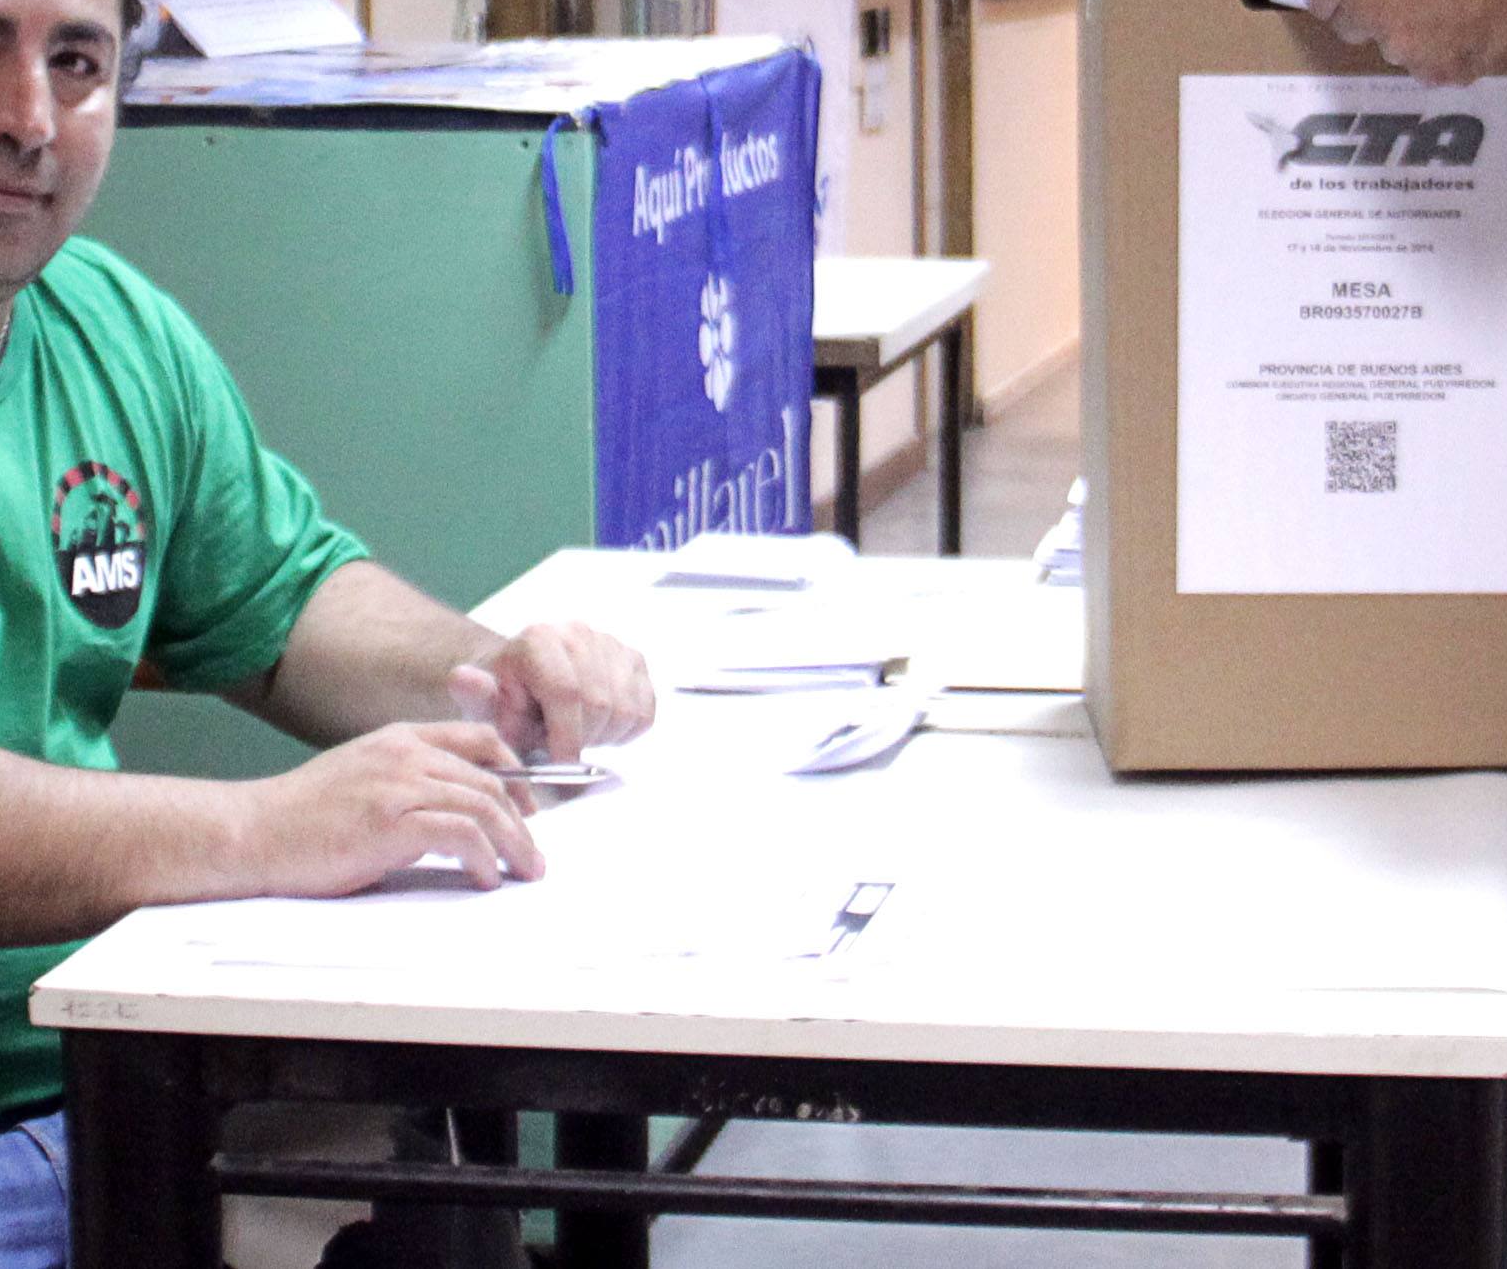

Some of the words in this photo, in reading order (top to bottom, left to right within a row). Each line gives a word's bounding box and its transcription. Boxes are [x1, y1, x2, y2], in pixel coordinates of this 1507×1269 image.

[1289, 178, 1313, 191] de
[1319, 178, 1345, 191] los
[1353, 177, 1475, 192] trabajadores
[1332, 282, 1392, 298] MESA
[1259, 364, 1333, 376] PROVINCIA
[1337, 364, 1357, 376] DE
[1360, 364, 1418, 376] BUENOS
[1422, 364, 1463, 376] AIRES
[71, 549, 141, 597] AMS
